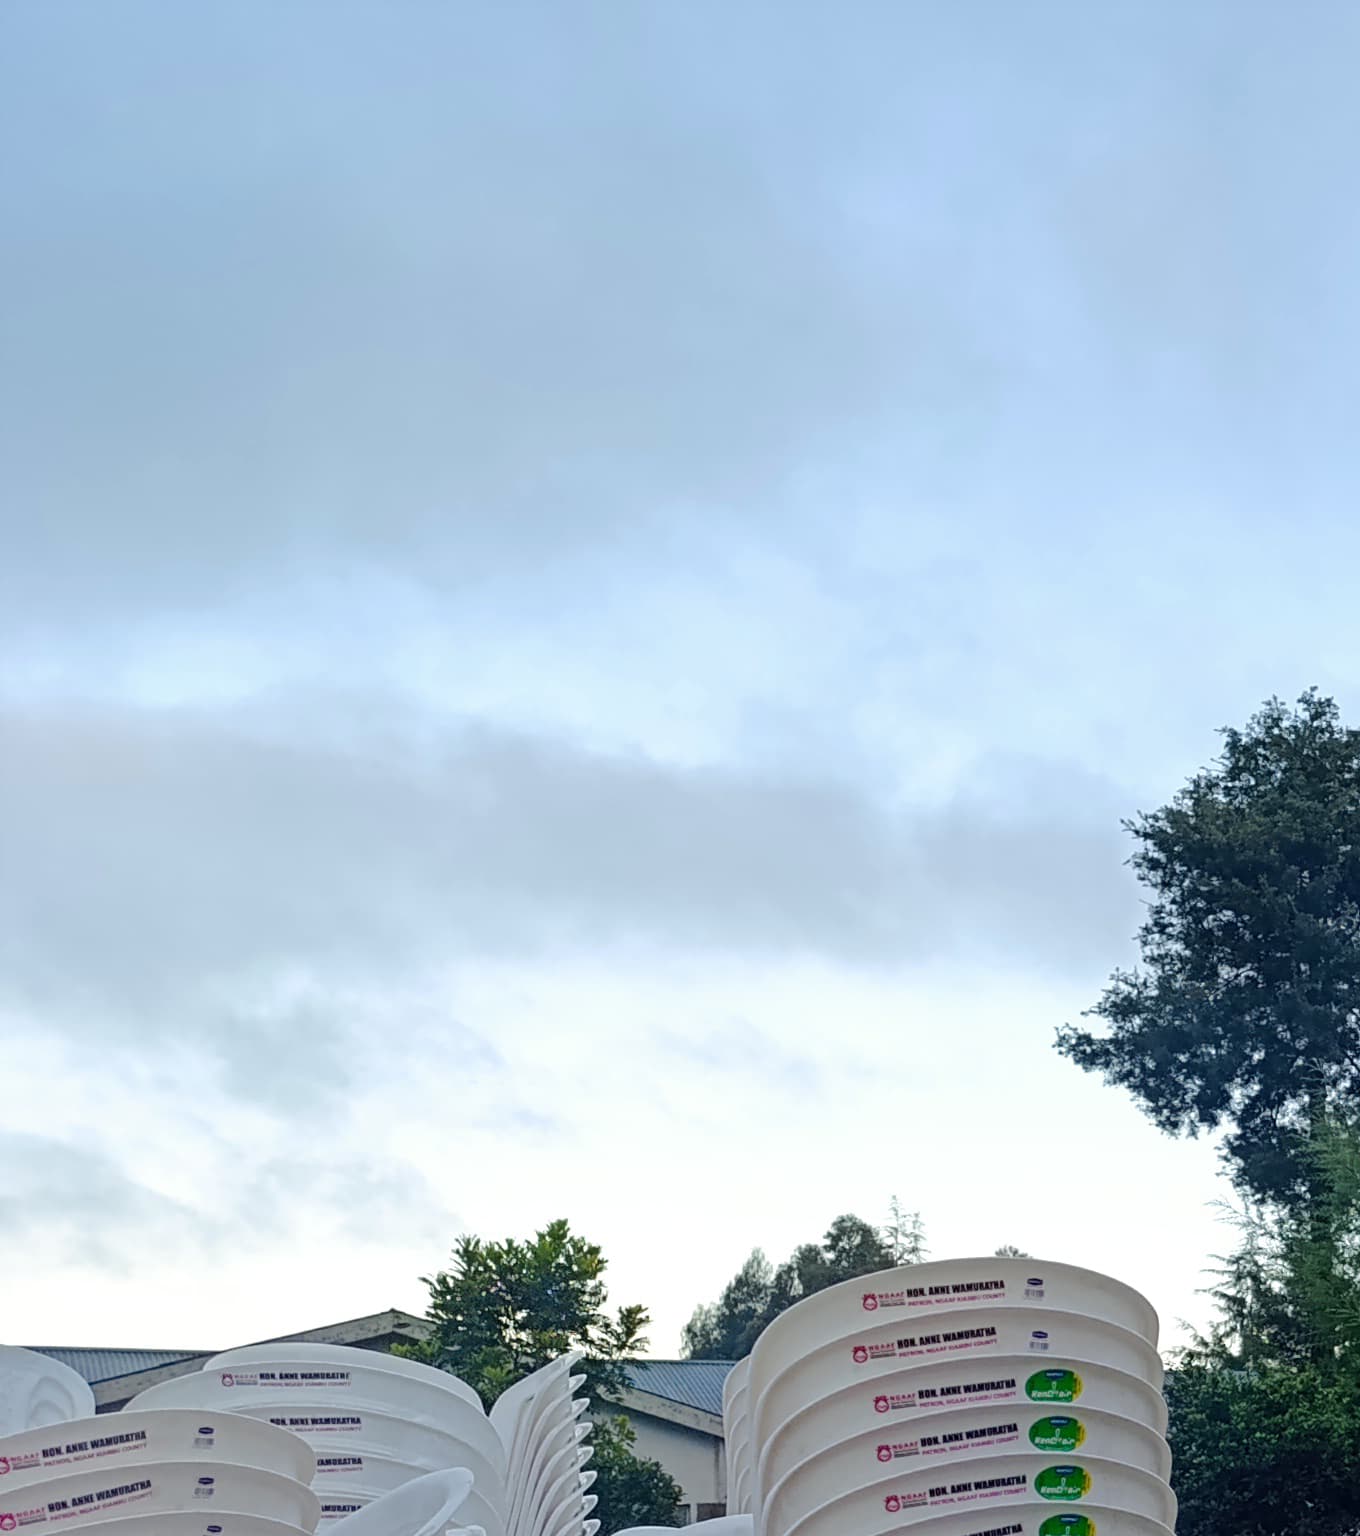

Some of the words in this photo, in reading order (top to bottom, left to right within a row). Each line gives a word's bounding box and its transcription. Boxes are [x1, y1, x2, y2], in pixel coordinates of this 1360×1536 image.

[928, 1285, 950, 1295] ANNE
[951, 1280, 1005, 1293] WAMURATHA
[919, 1334, 941, 1346] ANNE
[942, 1326, 996, 1342] WAMURATHA
[940, 1385, 961, 1396] ANNE
[962, 1378, 1016, 1393] WAMURATHA
[65, 1441, 88, 1454] ANNE
[90, 1430, 146, 1449] WAMURATHA
[942, 1432, 964, 1443] ANNE
[965, 1423, 1018, 1440] WAMURATHA
[71, 1494, 94, 1507] ANNE
[95, 1479, 152, 1501] WAMURATHA
[950, 1482, 972, 1494] ANNE
[973, 1474, 1027, 1490] WAMURATHA
